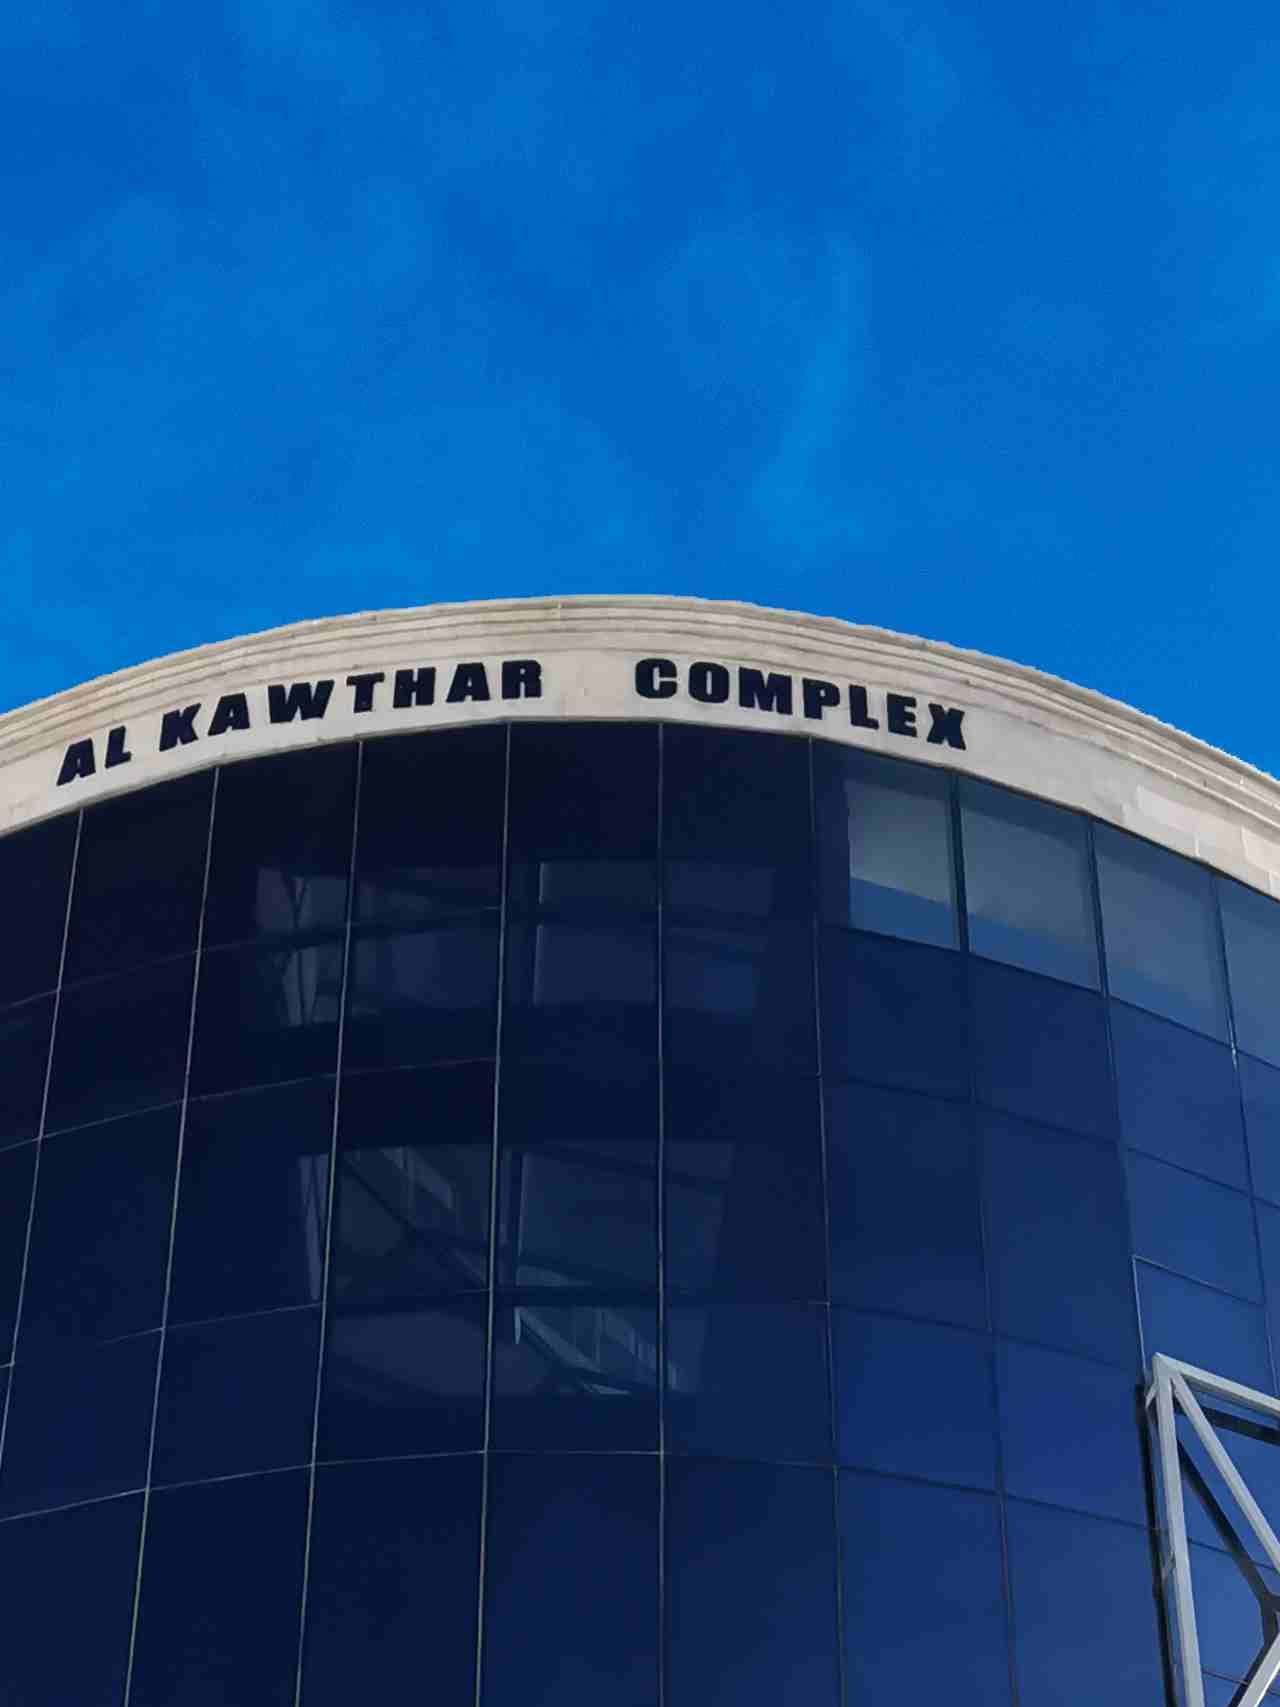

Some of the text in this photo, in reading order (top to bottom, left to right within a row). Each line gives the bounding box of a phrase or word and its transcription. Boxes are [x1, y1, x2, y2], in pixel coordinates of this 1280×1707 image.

[56, 657, 967, 787] AL KAWTHAR COMPLEX
